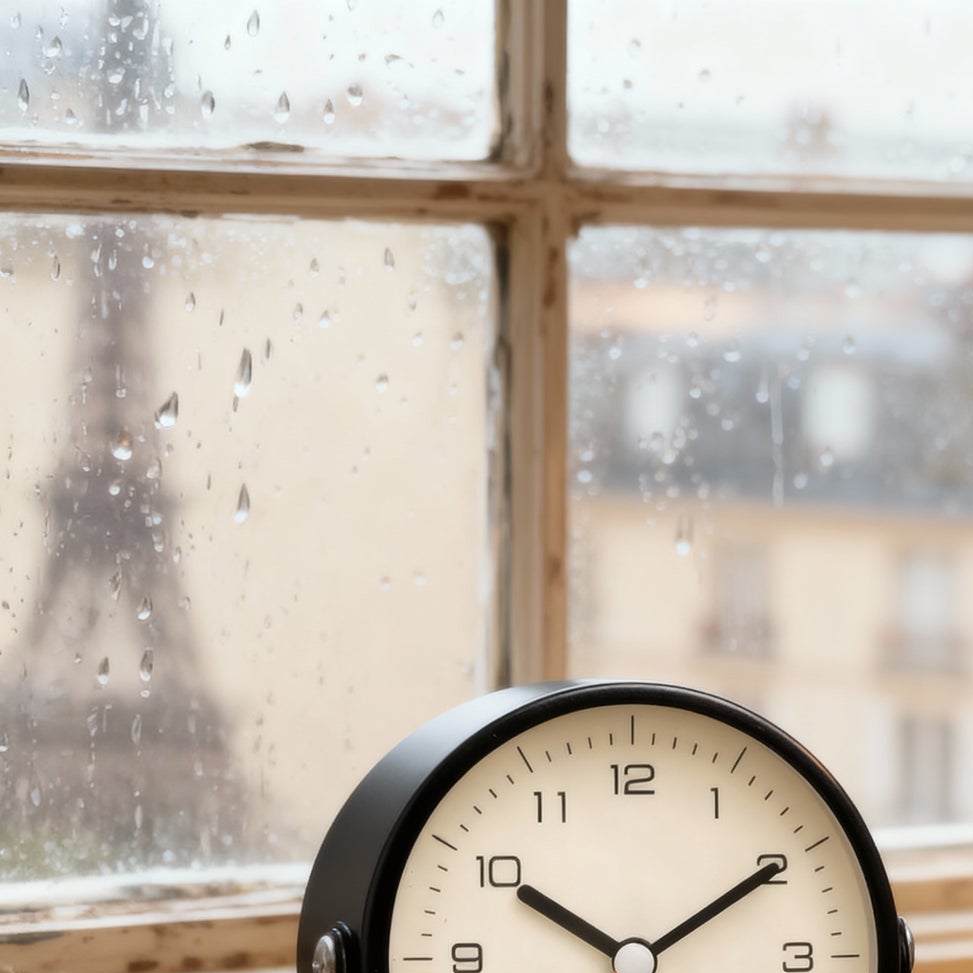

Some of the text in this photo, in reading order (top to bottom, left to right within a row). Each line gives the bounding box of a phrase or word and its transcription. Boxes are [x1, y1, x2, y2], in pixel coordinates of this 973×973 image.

[609, 763, 655, 795] 12
[533, 791, 567, 824] 11
[709, 787, 720, 820] 1
[475, 855, 521, 888] 10
[757, 854, 788, 885] 2
[782, 941, 814, 973] 3
